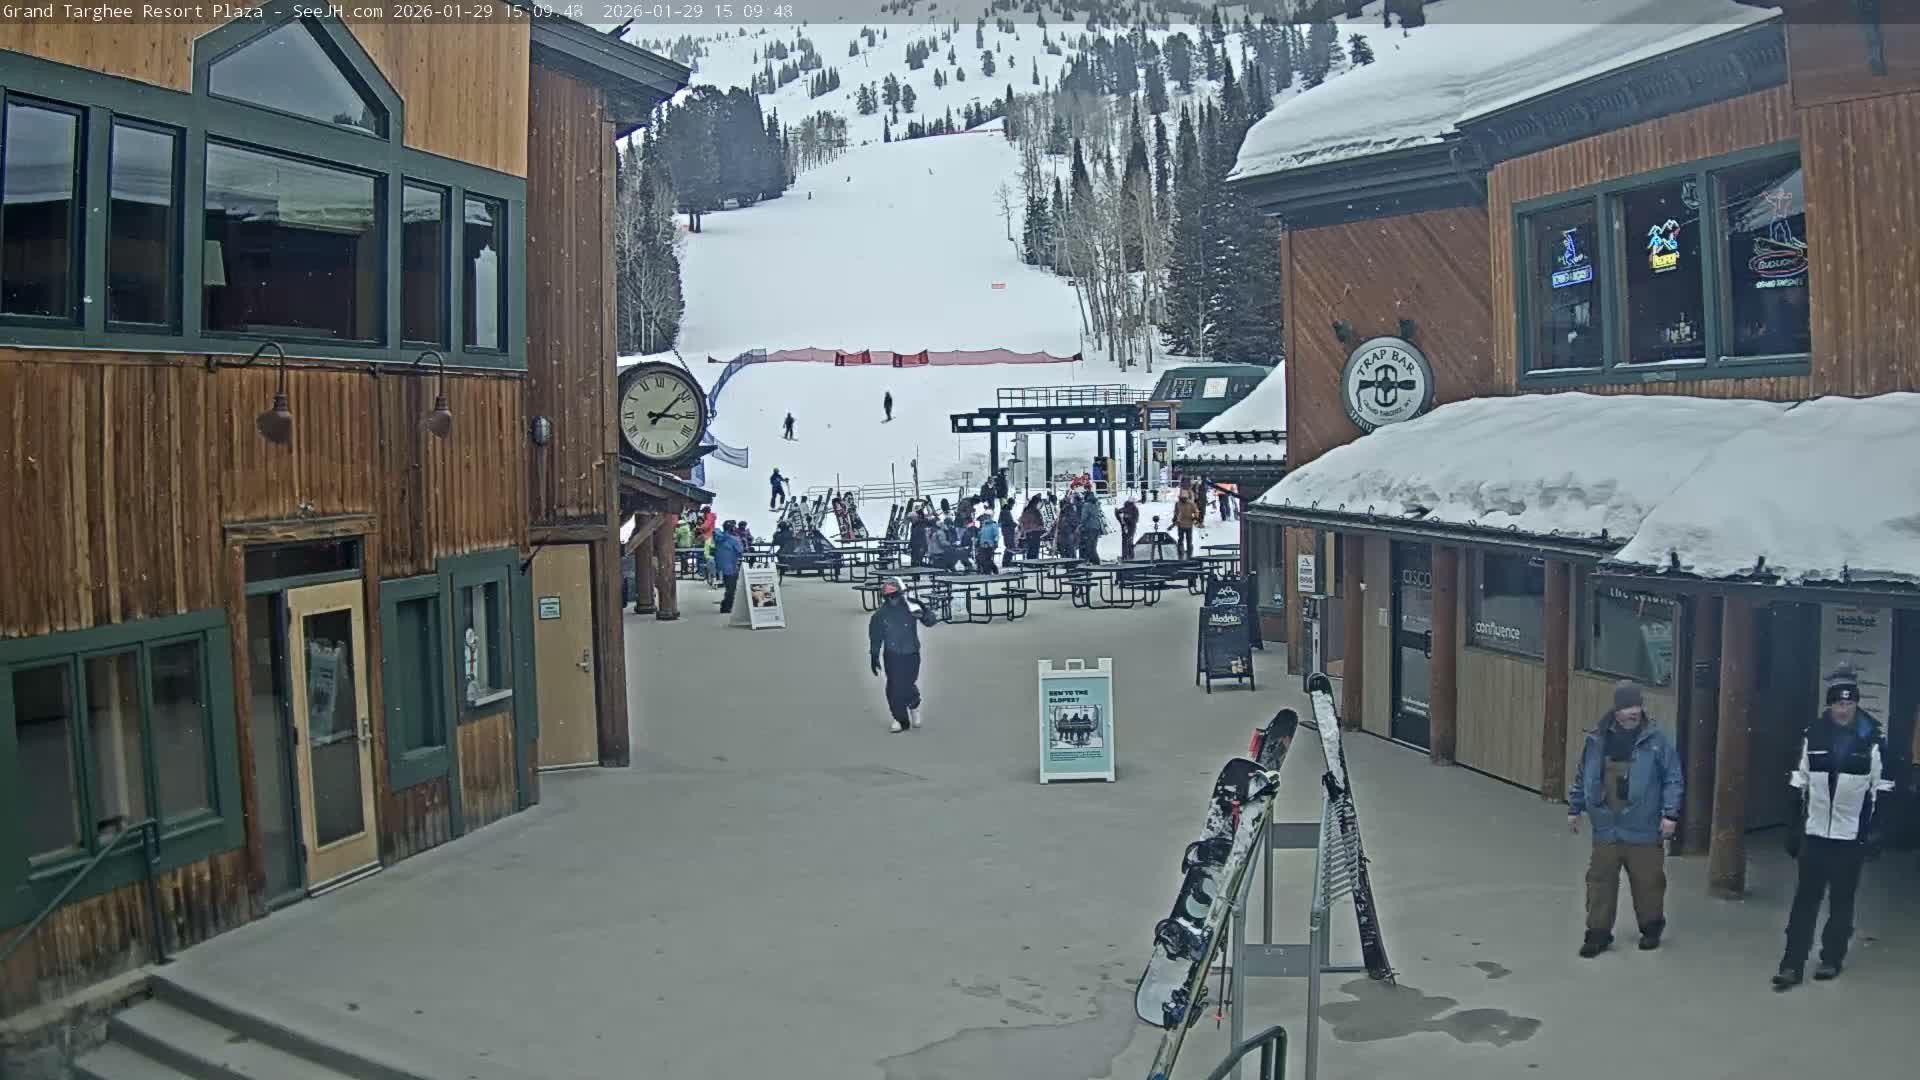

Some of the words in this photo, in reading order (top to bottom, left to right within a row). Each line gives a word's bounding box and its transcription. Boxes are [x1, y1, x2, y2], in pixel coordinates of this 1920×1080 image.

[1356, 349, 1387, 377] TRAP
[1391, 350, 1415, 376] BAR
[1475, 621, 1520, 640] confluence
